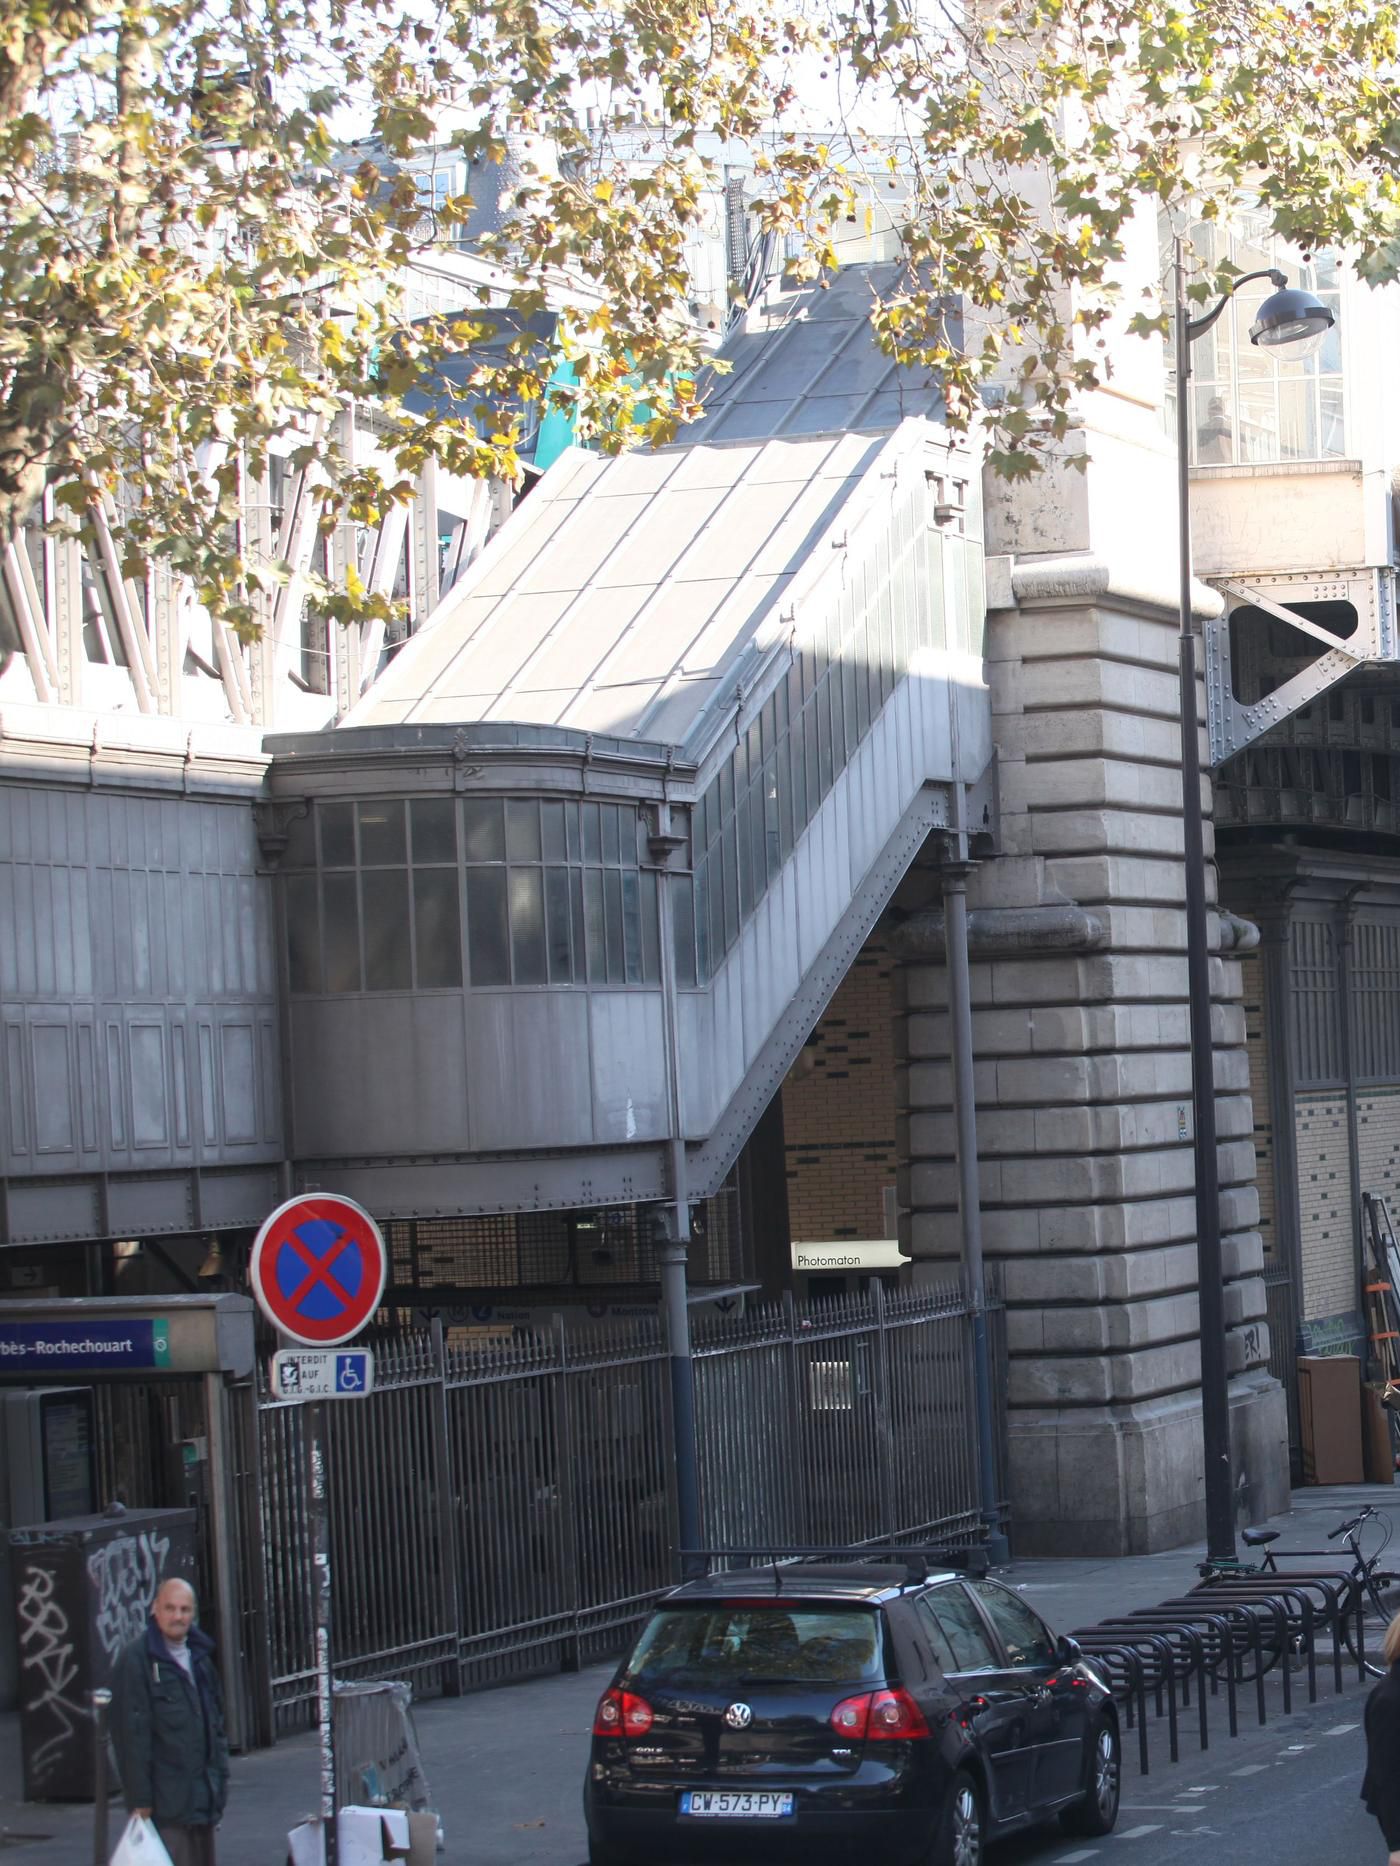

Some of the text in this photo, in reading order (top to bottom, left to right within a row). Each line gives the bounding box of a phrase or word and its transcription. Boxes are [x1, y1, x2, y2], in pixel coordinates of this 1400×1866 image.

[797, 1255, 861, 1266] Photomaton
[0, 1339, 133, 1356] bès-Rochechouart
[287, 1355, 328, 1365] INTERDIT
